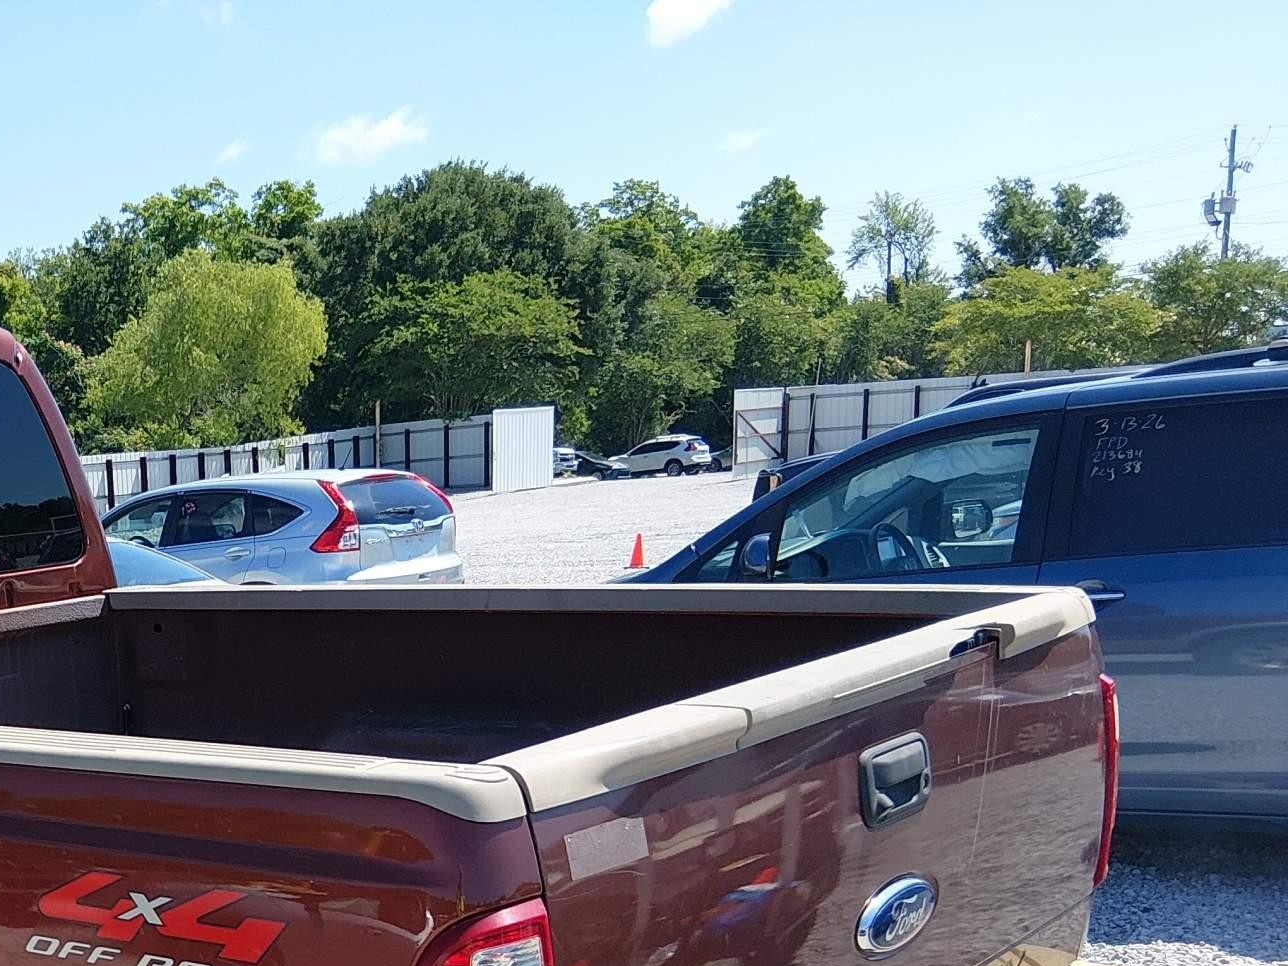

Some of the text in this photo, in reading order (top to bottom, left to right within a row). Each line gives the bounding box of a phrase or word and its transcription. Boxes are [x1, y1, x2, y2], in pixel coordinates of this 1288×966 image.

[1095, 413, 1167, 436] 3-13-26
[1123, 460, 1143, 474] 38
[885, 893, 927, 942] Ford
[25, 934, 122, 964] OFF
